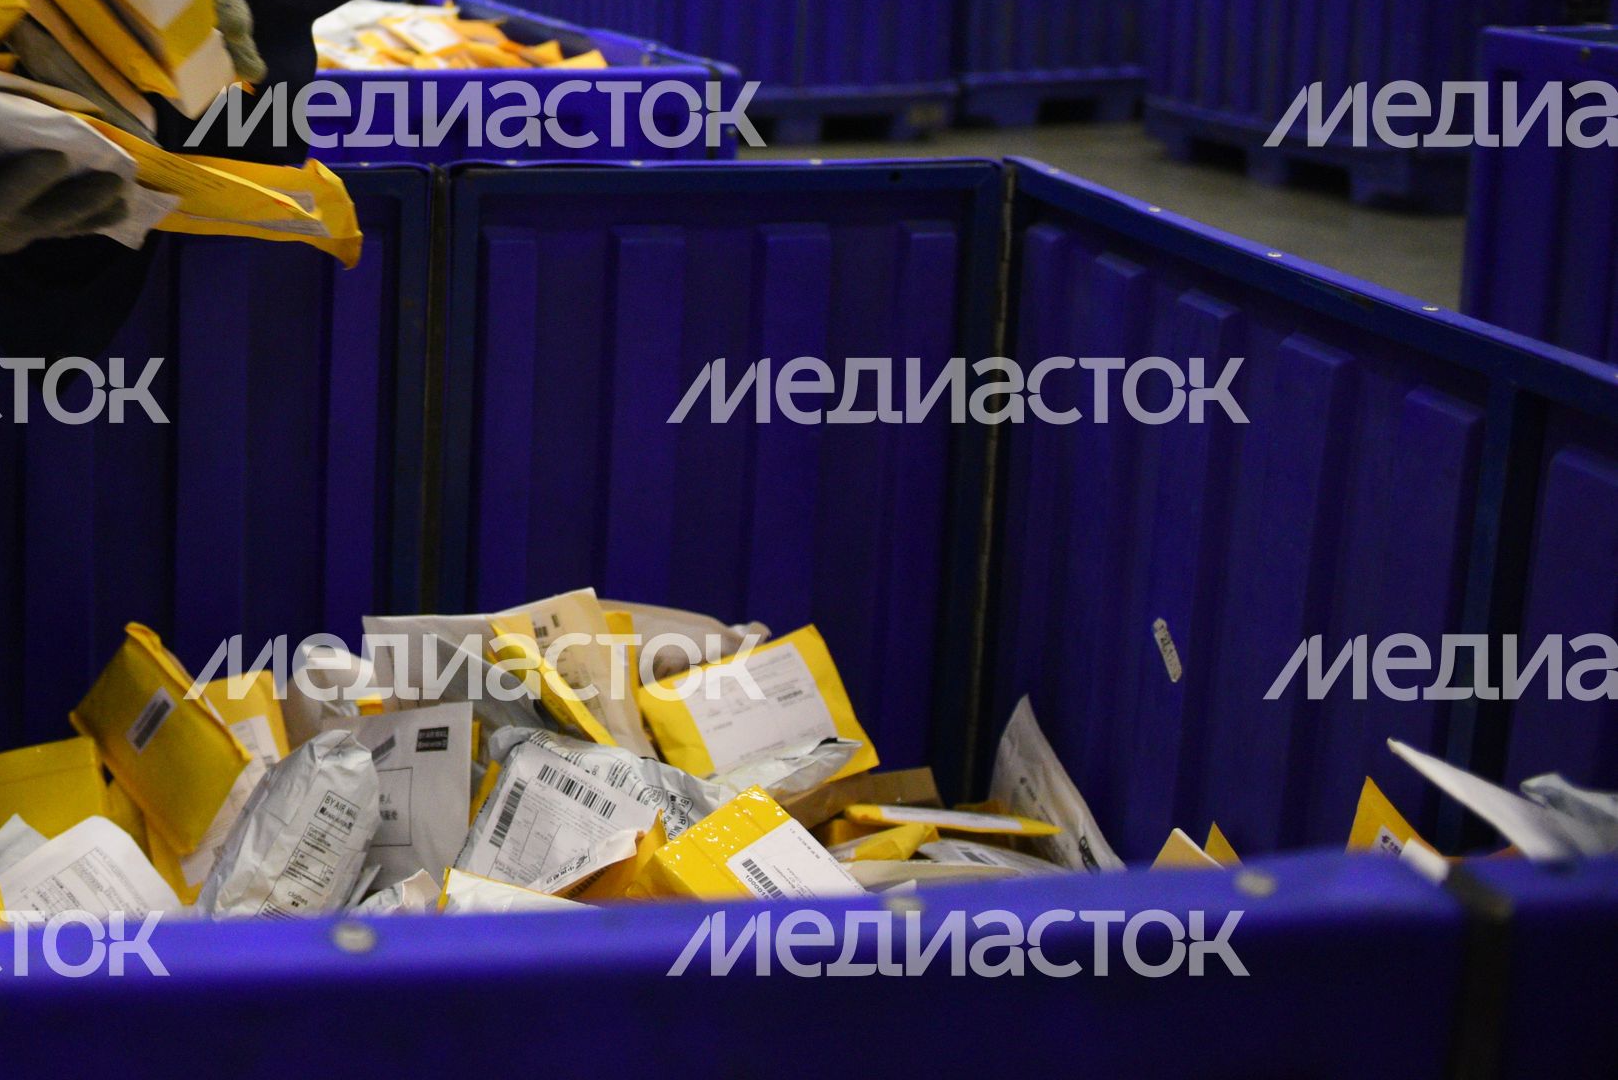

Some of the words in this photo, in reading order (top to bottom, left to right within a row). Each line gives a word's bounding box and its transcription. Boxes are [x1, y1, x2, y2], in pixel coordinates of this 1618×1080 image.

[324, 794, 335, 807] BY
[335, 800, 347, 813] AIR
[677, 811, 688, 825] AIR
